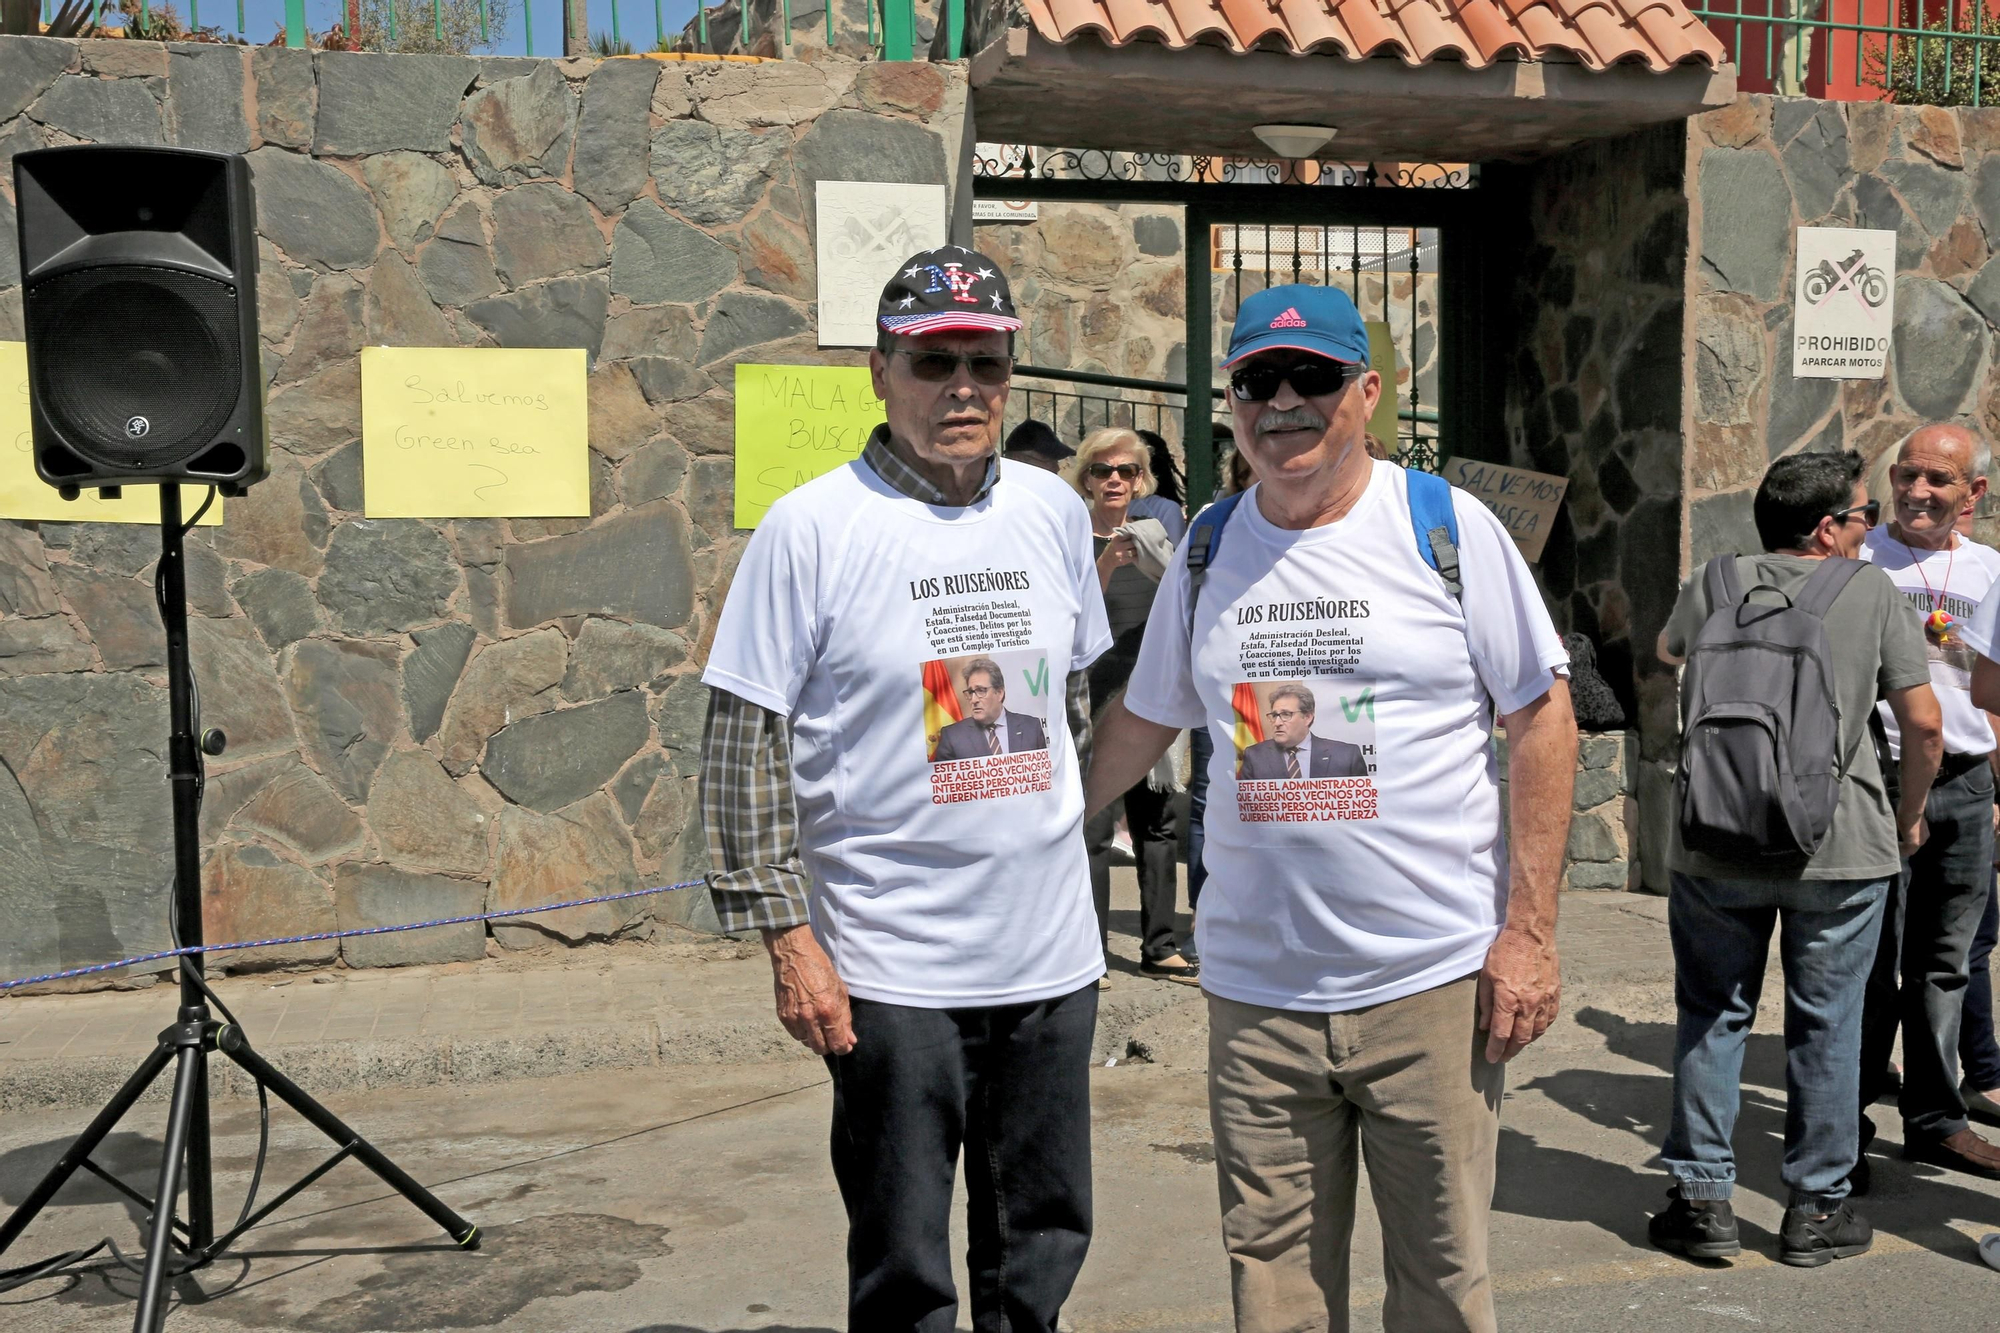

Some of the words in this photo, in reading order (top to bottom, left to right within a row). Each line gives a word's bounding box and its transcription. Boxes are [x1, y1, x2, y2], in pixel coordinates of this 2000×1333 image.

[1270, 319, 1306, 328] adidas
[1798, 336, 1888, 351] PROHIBIDO
[1802, 358, 1846, 366] APARCAR
[1849, 359, 1882, 367] MOTOS
[763, 373, 847, 413] MALA
[395, 425, 474, 450] Green
[1458, 462, 1562, 502] SALVEMOS
[910, 577, 940, 600] LOS
[943, 568, 1030, 596] RUISEÑORES
[932, 602, 989, 616] Administración
[992, 600, 1020, 610] Desleal,
[1237, 605, 1262, 625] LOS
[1268, 596, 1370, 622] RUISEÑORES
[925, 616, 953, 627] Estafa,
[955, 611, 988, 623] Falsedad
[990, 609, 1031, 620] Documental
[926, 630, 931, 638] y
[933, 623, 978, 636] Coacciones,
[980, 620, 1005, 630] Delitos
[1007, 622, 1019, 631] por
[1249, 630, 1313, 640] Administración
[1316, 628, 1350, 637] Desleal,
[931, 638, 945, 647] que
[947, 635, 963, 643] está
[966, 631, 989, 641] siendo
[991, 627, 1032, 640] investigado
[1241, 642, 1267, 650] Estafa,
[1270, 638, 1308, 648] Falsedad
[1311, 637, 1364, 646] Documental
[950, 645, 959, 653] un
[962, 641, 994, 652] Complejo
[996, 638, 1029, 648] Turístico
[1239, 653, 1244, 661] y
[1246, 650, 1294, 658] Coacciones,
[1297, 648, 1326, 656] Delitos
[1330, 648, 1345, 657] por
[1348, 647, 1361, 655] los
[1242, 662, 1256, 670] que
[1258, 659, 1276, 668] está
[1278, 658, 1306, 667] siendo
[1308, 656, 1360, 666] investigado
[1273, 668, 1312, 678] Complejo
[1313, 666, 1354, 674] Turístico
[930, 773, 953, 783] QUE
[955, 767, 1003, 782] ALGUNOS
[1005, 761, 1040, 775] VECINOS
[934, 762, 958, 773] ESTE
[959, 761, 971, 771] ES
[973, 759, 983, 769] EL
[933, 781, 984, 794] INTERESES
[987, 773, 1039, 788] PERSONALES
[1239, 782, 1255, 791] ESTE
[1257, 782, 1267, 791] ES
[1269, 781, 1279, 790] EL
[1282, 779, 1372, 791] ADMINISTRADOR
[932, 791, 978, 804] QUIEREN
[980, 787, 1010, 800] METER
[1013, 787, 1019, 796] A
[1021, 784, 1030, 793] LA
[1237, 792, 1252, 802] QUE
[1253, 792, 1300, 801] ALGUNOS
[1303, 790, 1353, 800] VECINOS
[1356, 789, 1378, 798] POR
[1238, 803, 1279, 812] INTERESES
[1282, 800, 1350, 811] PERSONALES
[1353, 799, 1377, 809] NOS
[1240, 813, 1274, 822] QUIEREN
[1277, 812, 1308, 822] METER
[1311, 812, 1319, 821] A
[1321, 812, 1335, 821] LA
[1337, 810, 1379, 820] FUERZA
